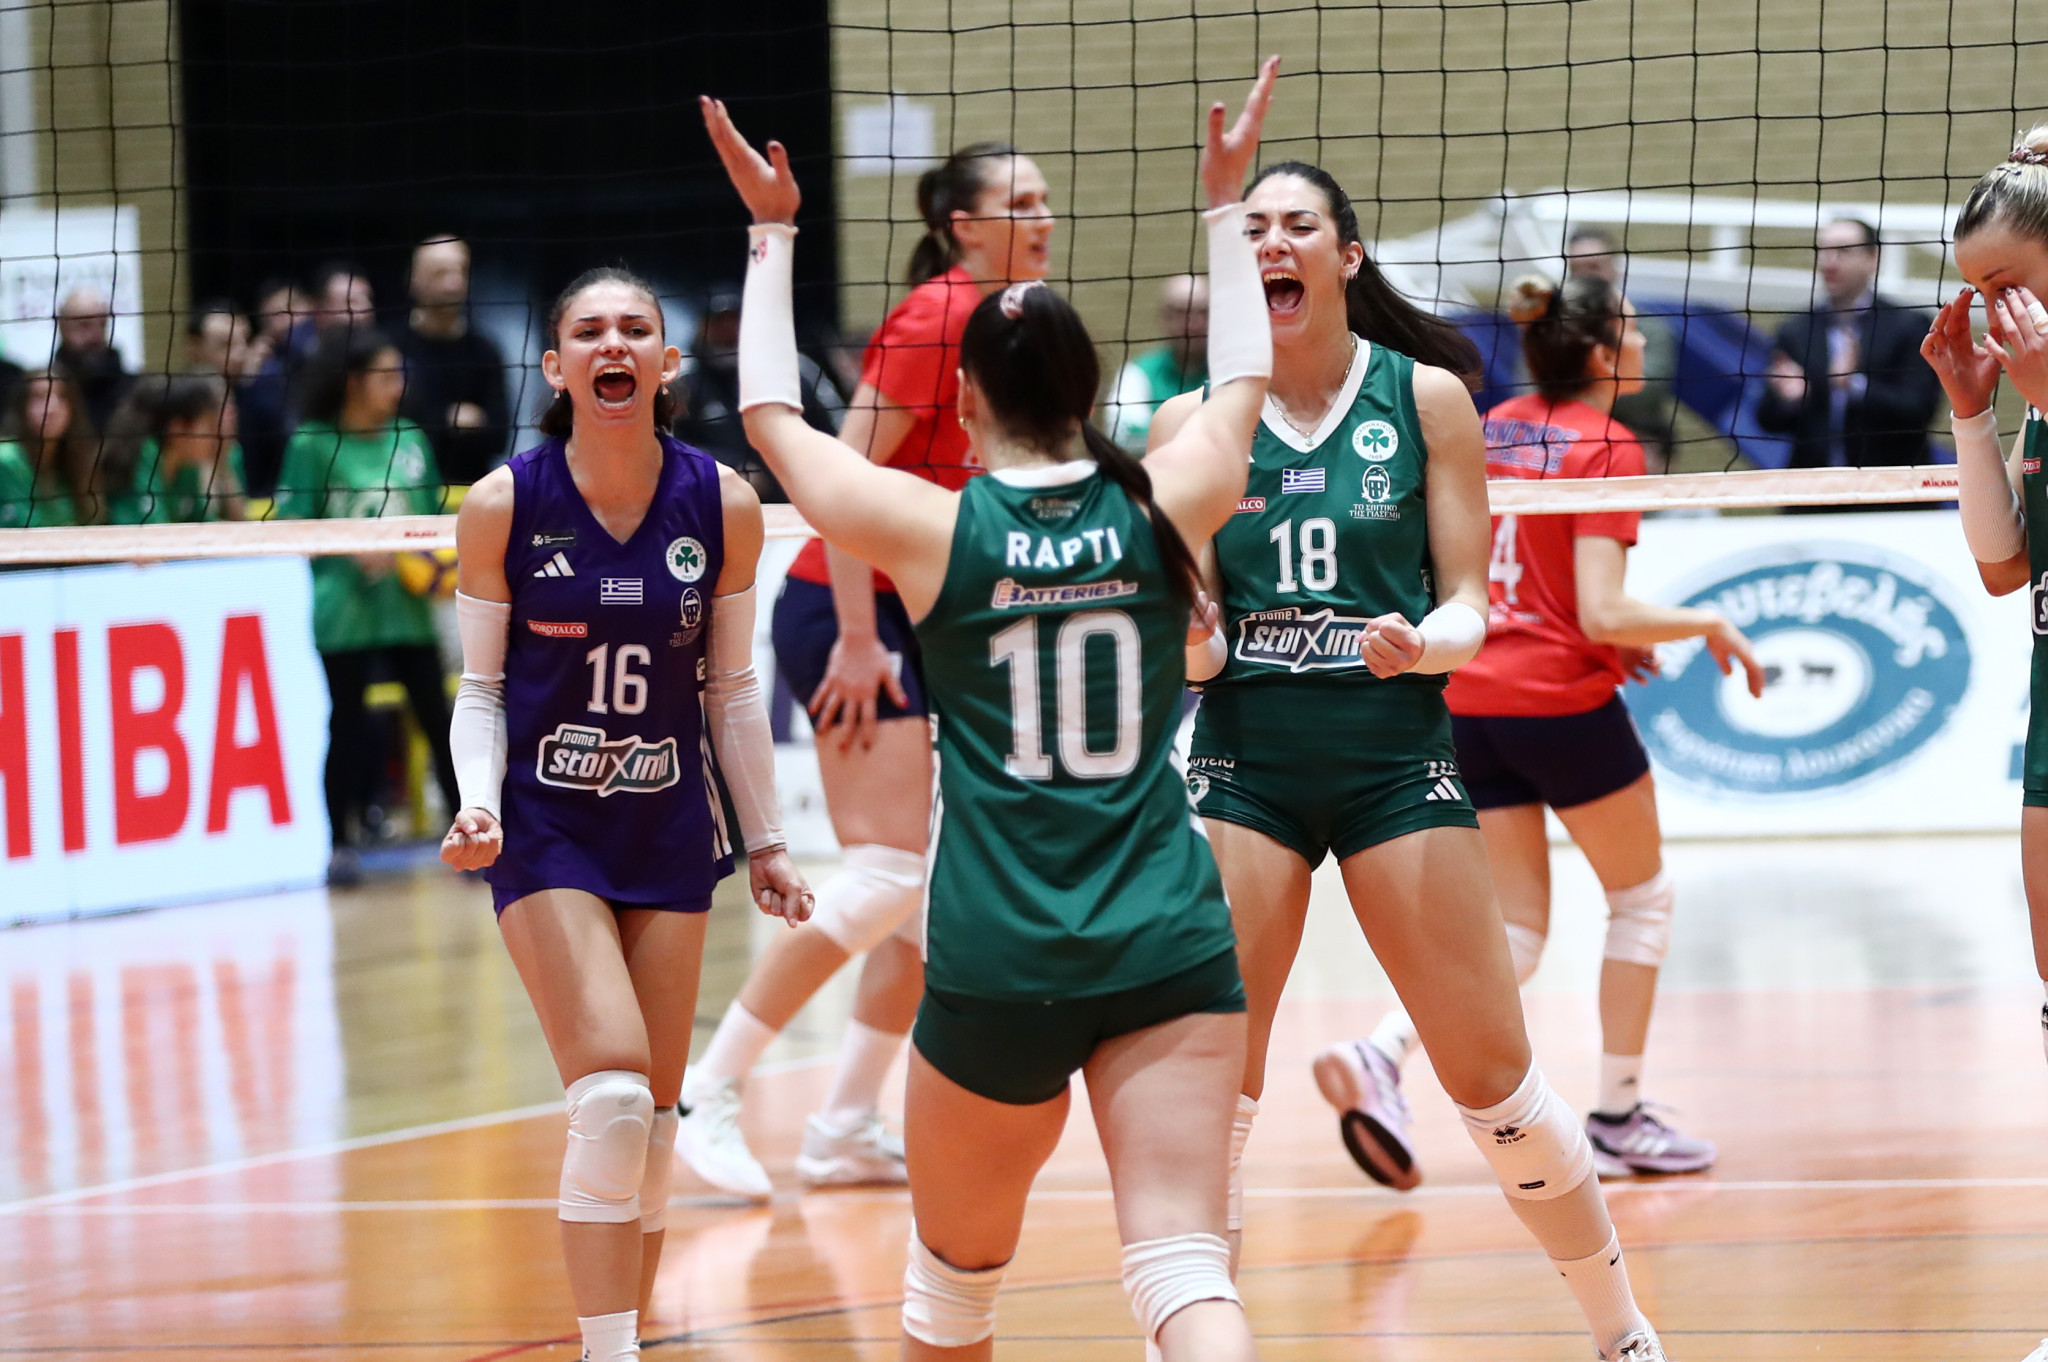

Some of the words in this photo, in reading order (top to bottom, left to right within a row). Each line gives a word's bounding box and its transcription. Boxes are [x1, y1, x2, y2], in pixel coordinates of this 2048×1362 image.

[1006, 527, 1123, 568] RAPTI
[1270, 517, 1338, 593] 18
[1258, 610, 1292, 621] pame
[586, 642, 651, 715] 16
[989, 609, 1142, 780] 10
[561, 731, 597, 747] pame
